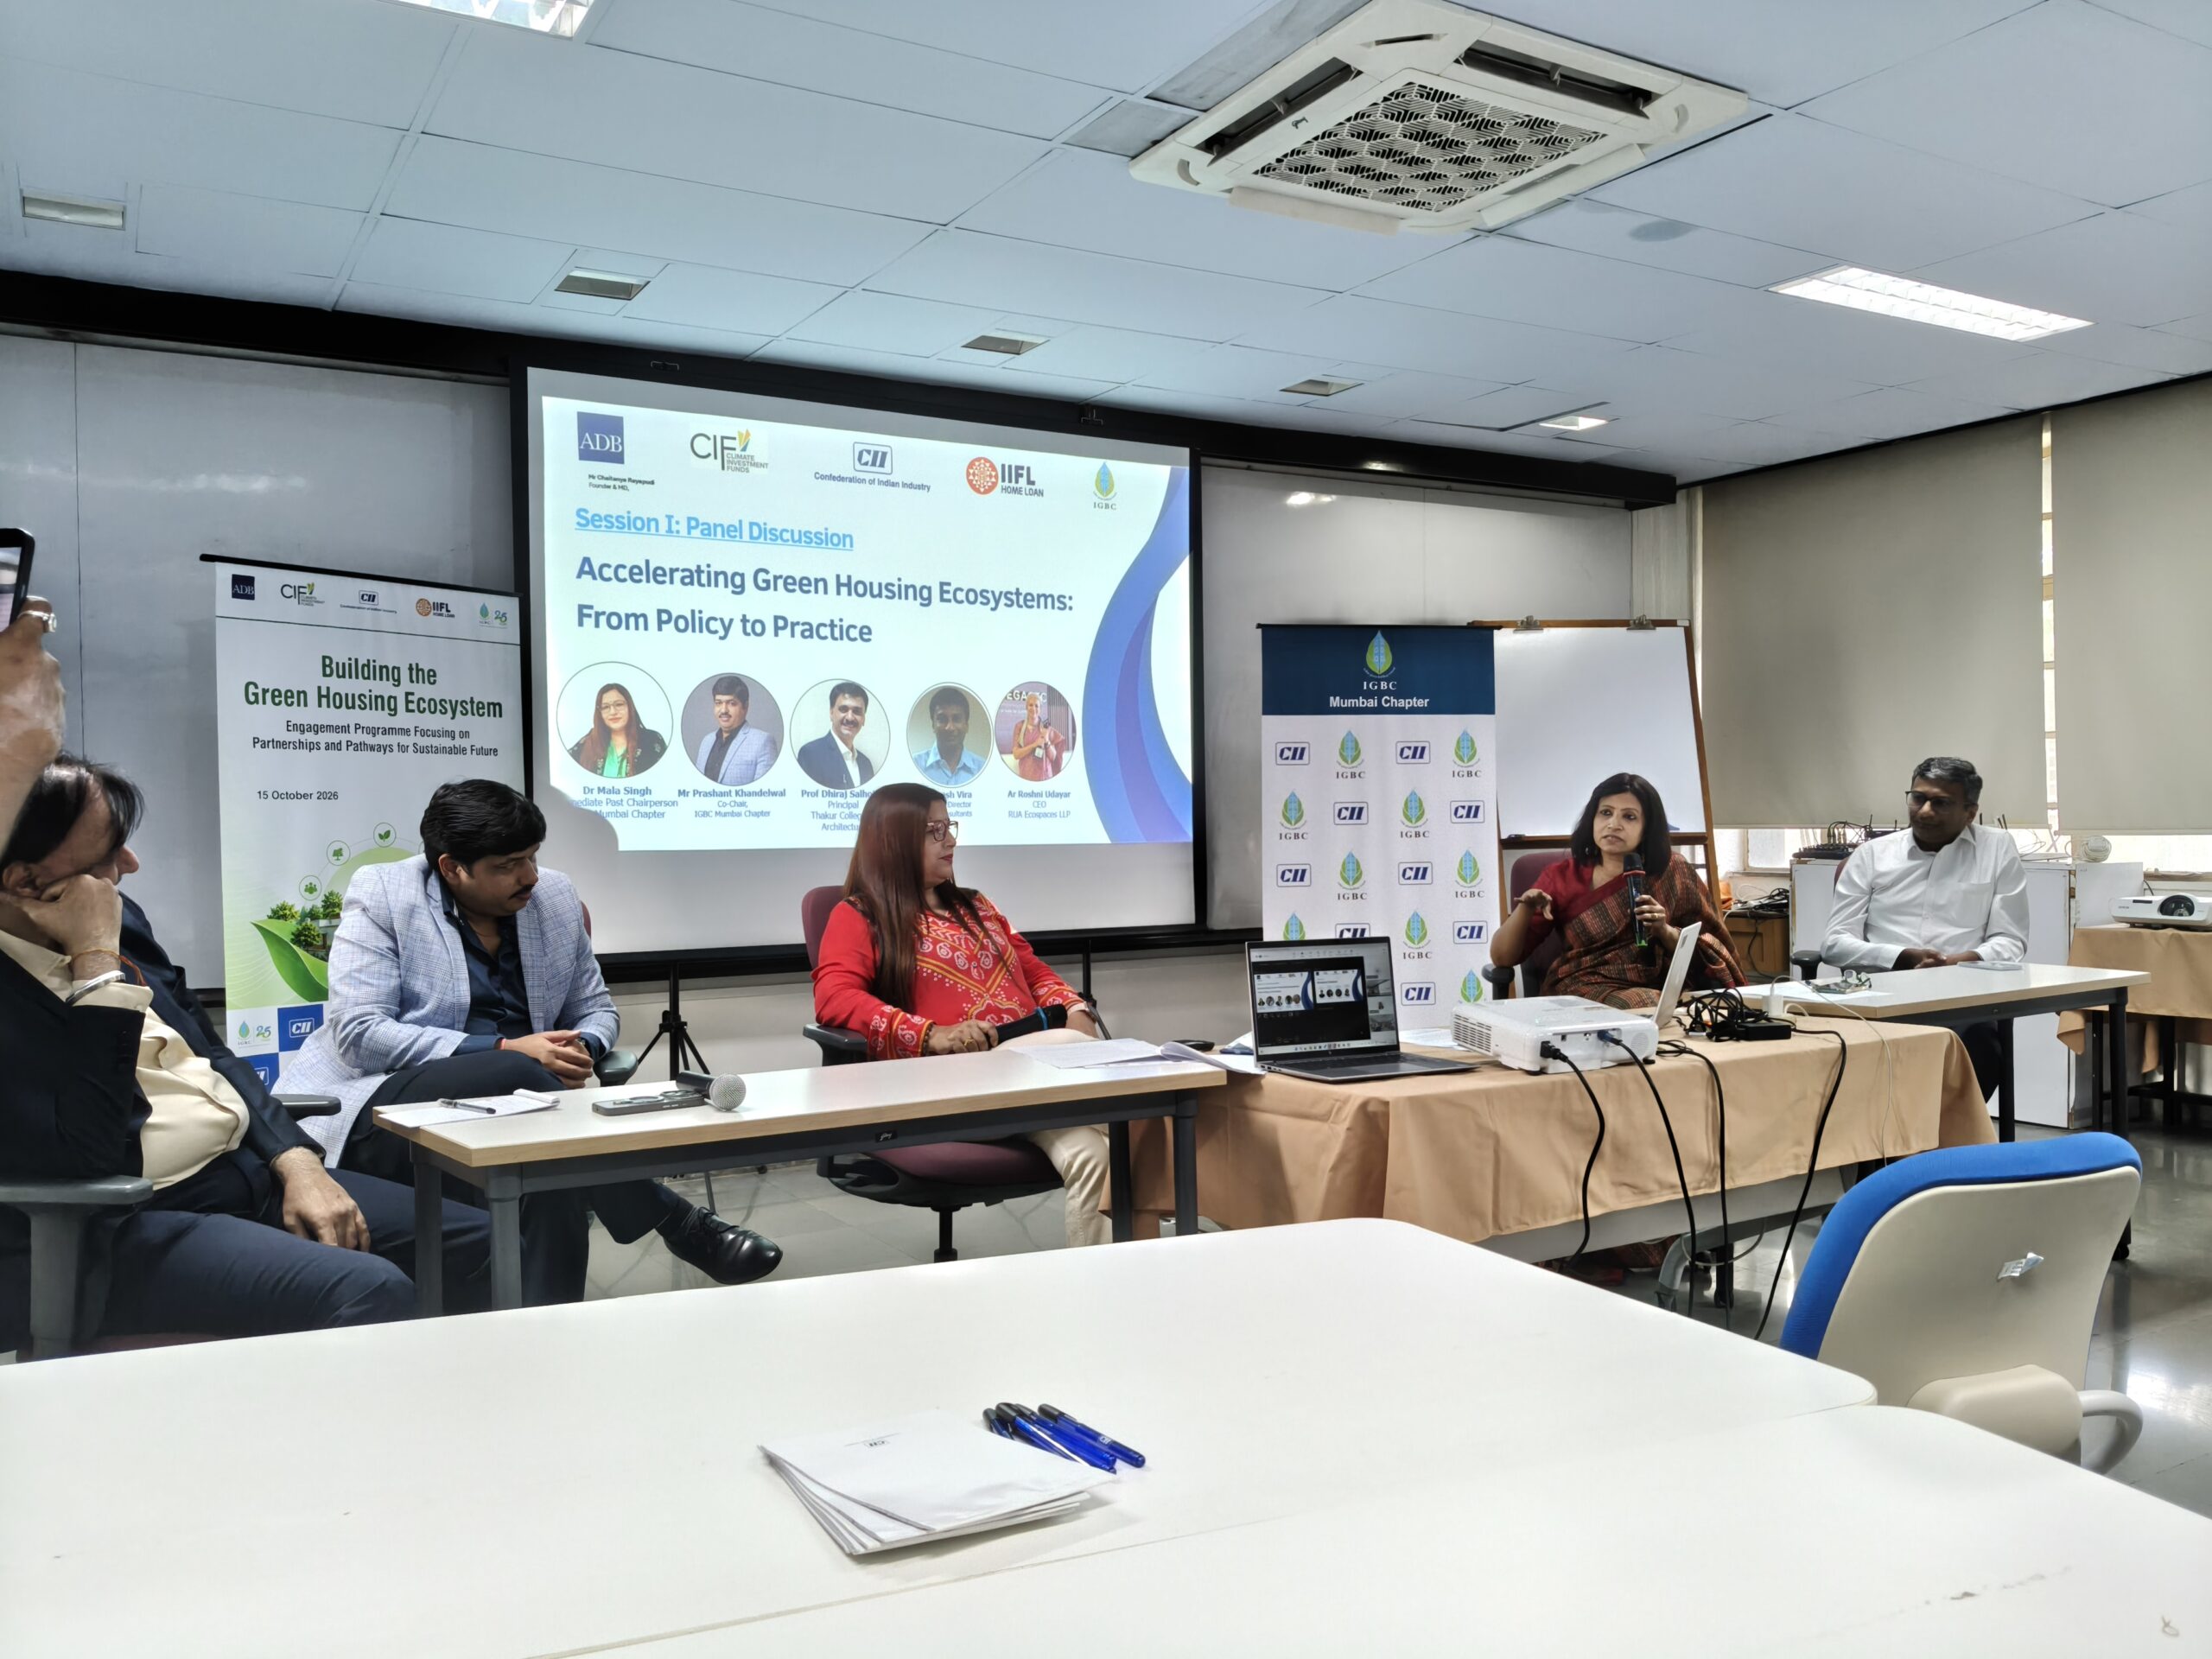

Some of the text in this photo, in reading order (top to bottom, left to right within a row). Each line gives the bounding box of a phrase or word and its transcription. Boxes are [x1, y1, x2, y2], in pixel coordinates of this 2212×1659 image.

[580, 432, 622, 453] ADB
[690, 433, 737, 471] CIF
[726, 453, 755, 461] CLIMATE
[857, 448, 888, 468] CII
[726, 459, 769, 469] INVESTMENT
[1001, 463, 1036, 486] IIFL
[814, 472, 867, 485] Confederation
[877, 478, 900, 488] Indian
[901, 481, 931, 493] Industry
[1001, 485, 1044, 498] HOME LOAN
[1093, 501, 1117, 511] IGBC
[575, 507, 855, 549] Session I: Panel Discussion
[232, 584, 255, 595] ADB
[575, 556, 1074, 612] Accelerating Green Housing Ecosystems:
[280, 583, 308, 605] CIF
[360, 593, 377, 603] CII
[432, 601, 451, 613] IIFL
[577, 603, 873, 643] From Policy to Practice
[321, 655, 437, 687] Building the
[1363, 681, 1397, 690] IGBC
[244, 681, 503, 720] Green Housing Ecosystem
[1329, 696, 1430, 709] Mumbai Chapter
[286, 720, 470, 741] Engagement Programme Focusing on
[252, 737, 499, 757] Partnerships and Pathways for Sustainable Future
[1399, 746, 1427, 760] CII
[1279, 747, 1306, 761] CII
[1336, 771, 1366, 779] IGBC
[1452, 770, 1482, 779] IGBC
[257, 790, 339, 800] 15 October 2026
[582, 786, 652, 798] Dr Mala Singh
[677, 788, 786, 798] Mr Prashant Khandelwal
[822, 789, 848, 800] Dhiraj
[1018, 790, 1043, 798] Roshni
[1045, 791, 1071, 800] Udayar
[606, 798, 624, 807] Past
[626, 798, 678, 809] Chairperson
[717, 800, 748, 809] Co-Chair,
[828, 800, 860, 810] Principal
[631, 810, 666, 820] Chapter
[715, 810, 742, 818] Mumbai
[744, 810, 771, 818] Chapter
[810, 810, 837, 820] Thakur
[1337, 806, 1365, 821] CII
[1453, 805, 1481, 819] CII
[821, 823, 860, 831] Architectu
[1279, 832, 1309, 841] IGBC
[1400, 830, 1431, 839] IGBC
[1280, 868, 1308, 882] CII
[1402, 867, 1429, 880] CII
[1455, 890, 1485, 899] IGBC
[1456, 925, 1484, 940] CII
[1402, 951, 1433, 960] IGBC
[1404, 987, 1432, 1001] CII
[256, 1025, 271, 1039] 25
[291, 1021, 312, 1034] CII
